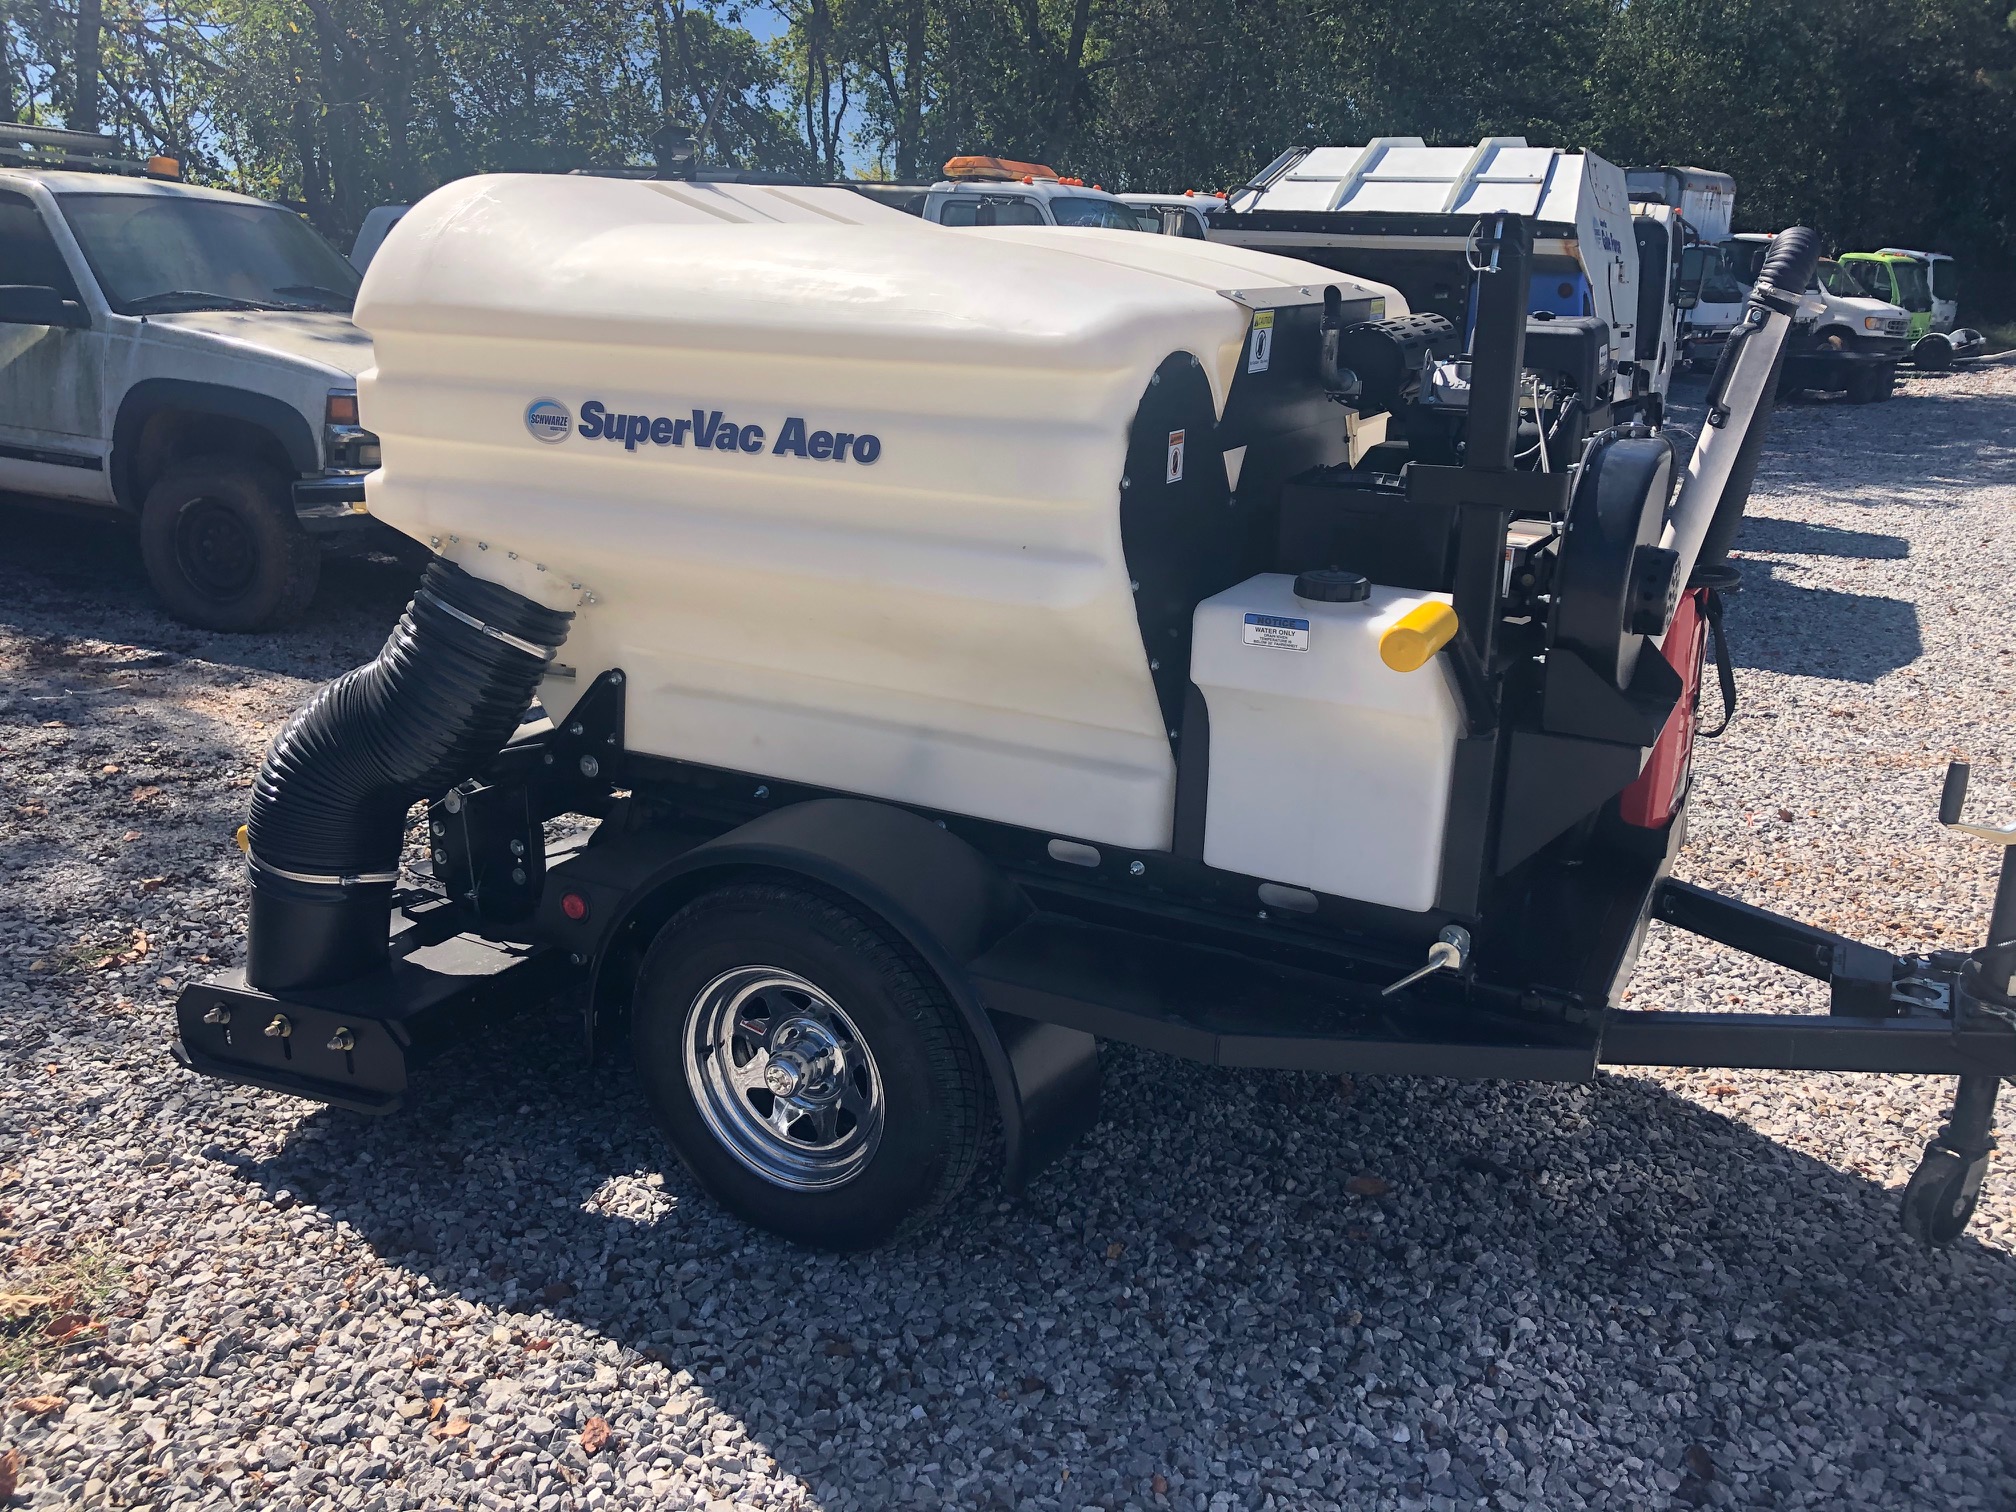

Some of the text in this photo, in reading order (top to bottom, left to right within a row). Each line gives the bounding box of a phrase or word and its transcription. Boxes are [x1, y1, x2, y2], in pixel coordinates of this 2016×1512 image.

[530, 413, 568, 427] SCHWARZE
[578, 400, 882, 466] SuperVac Aero
[1257, 616, 1296, 628] NOTICE
[1255, 626, 1296, 637] WATER ONLY
